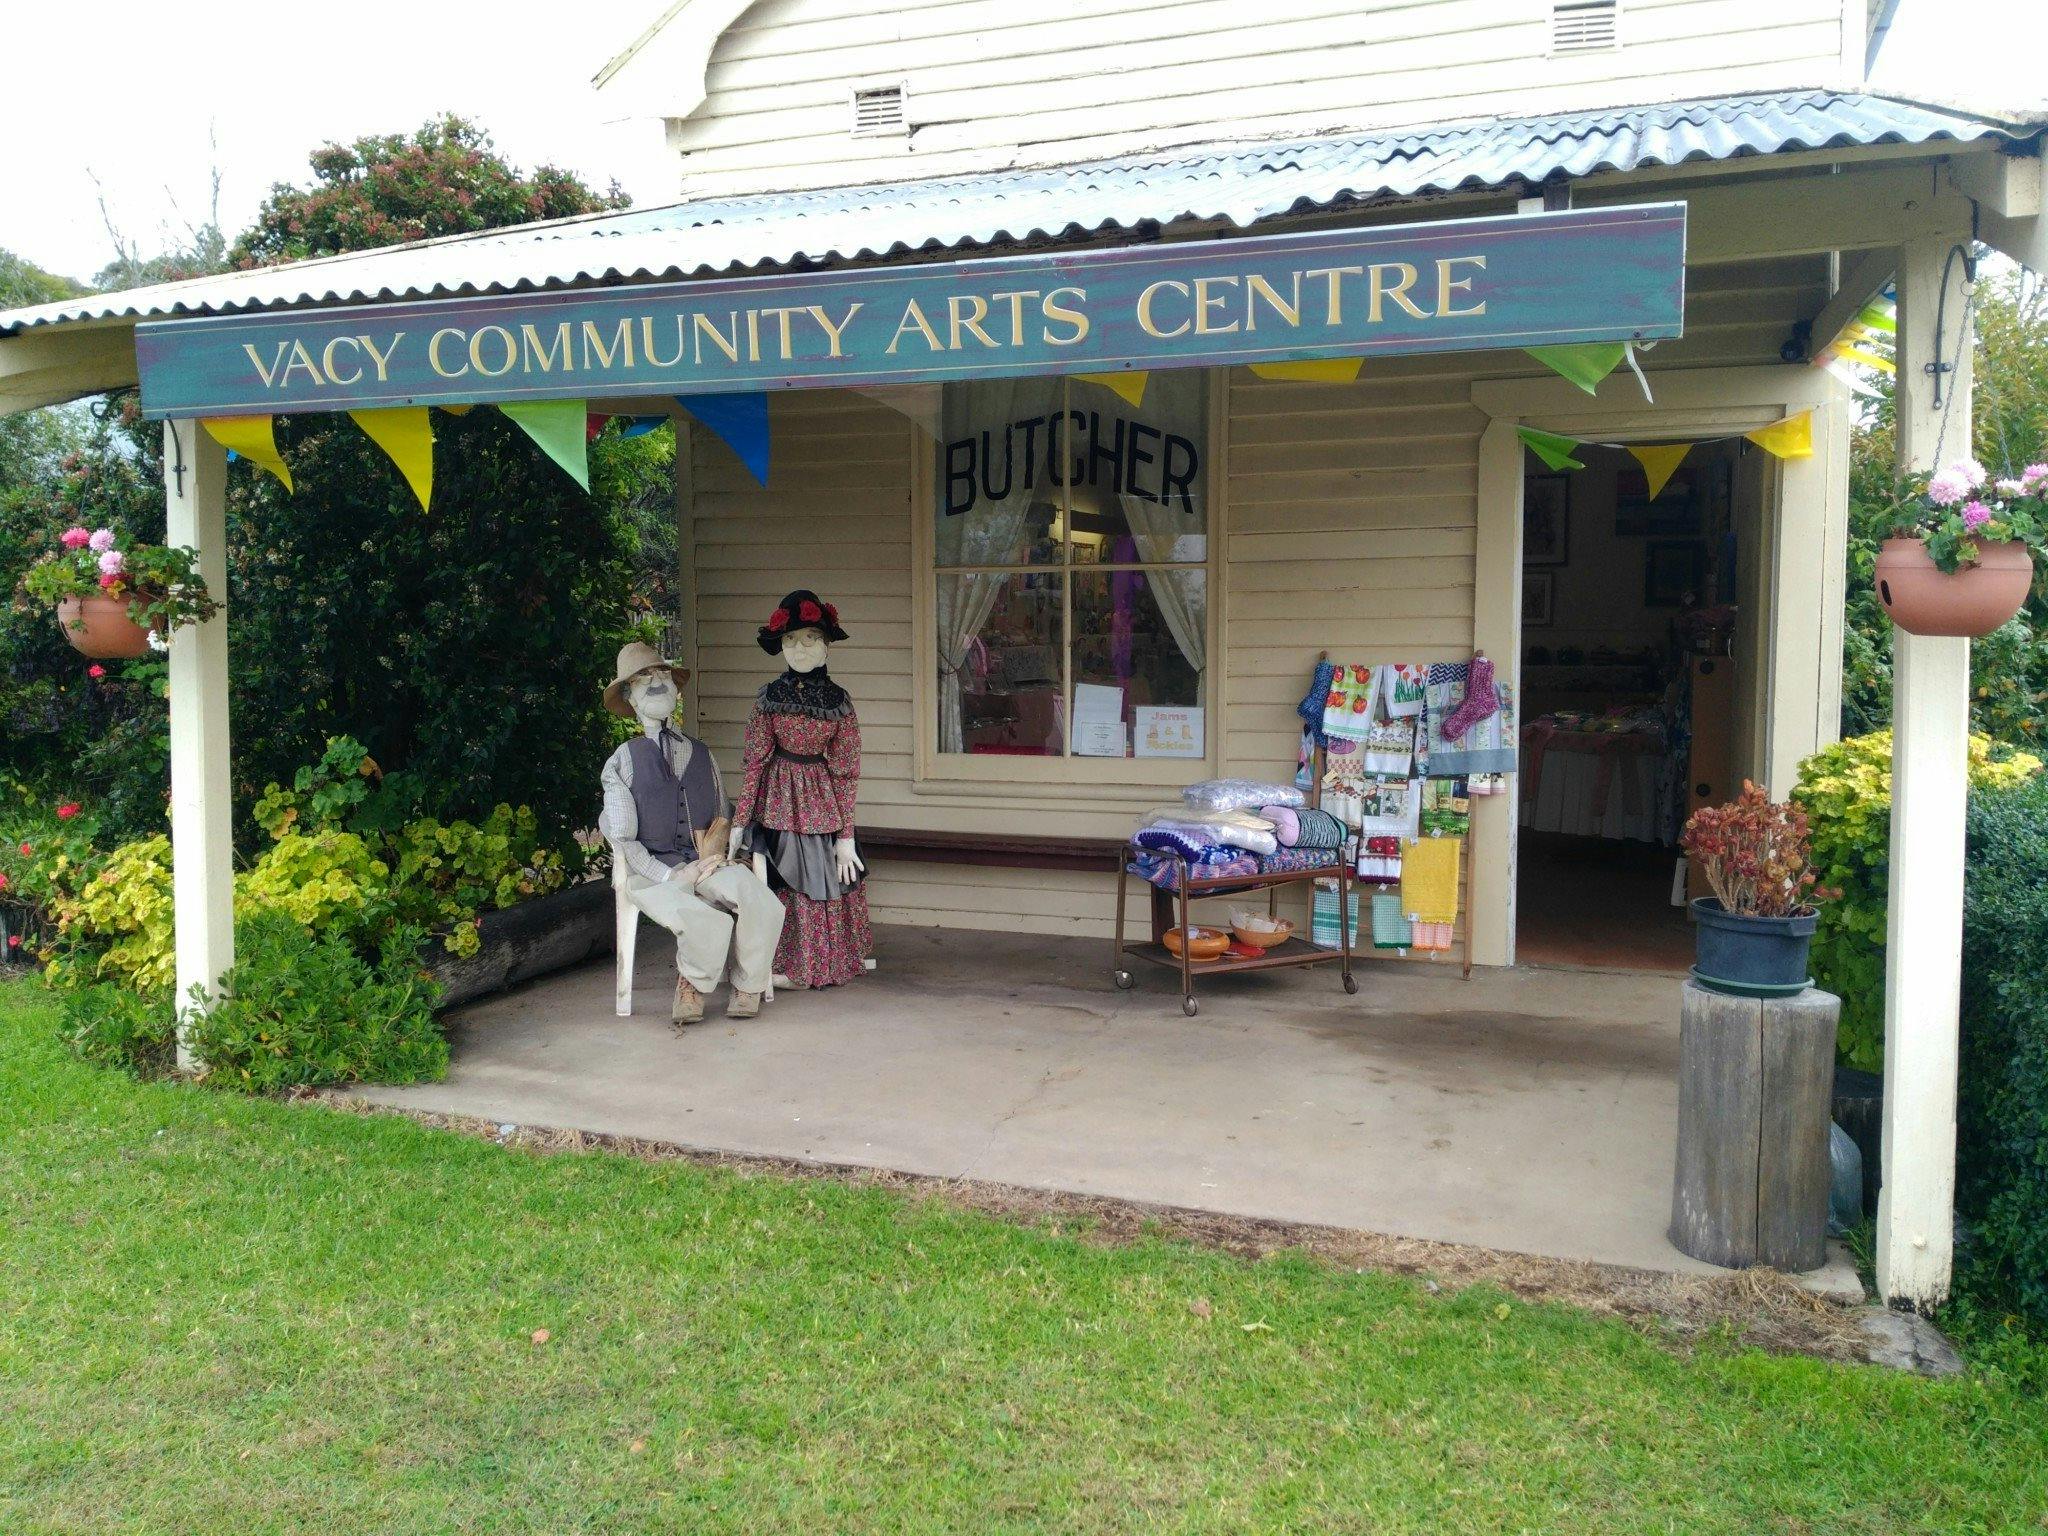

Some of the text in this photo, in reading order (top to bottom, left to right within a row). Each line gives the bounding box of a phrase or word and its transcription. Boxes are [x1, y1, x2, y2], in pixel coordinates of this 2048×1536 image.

[242, 255, 1488, 388] VACY COMMUNITY ARTS CENTRE
[945, 410, 1199, 516] BUTCHER
[1151, 711, 1188, 721] Jams
